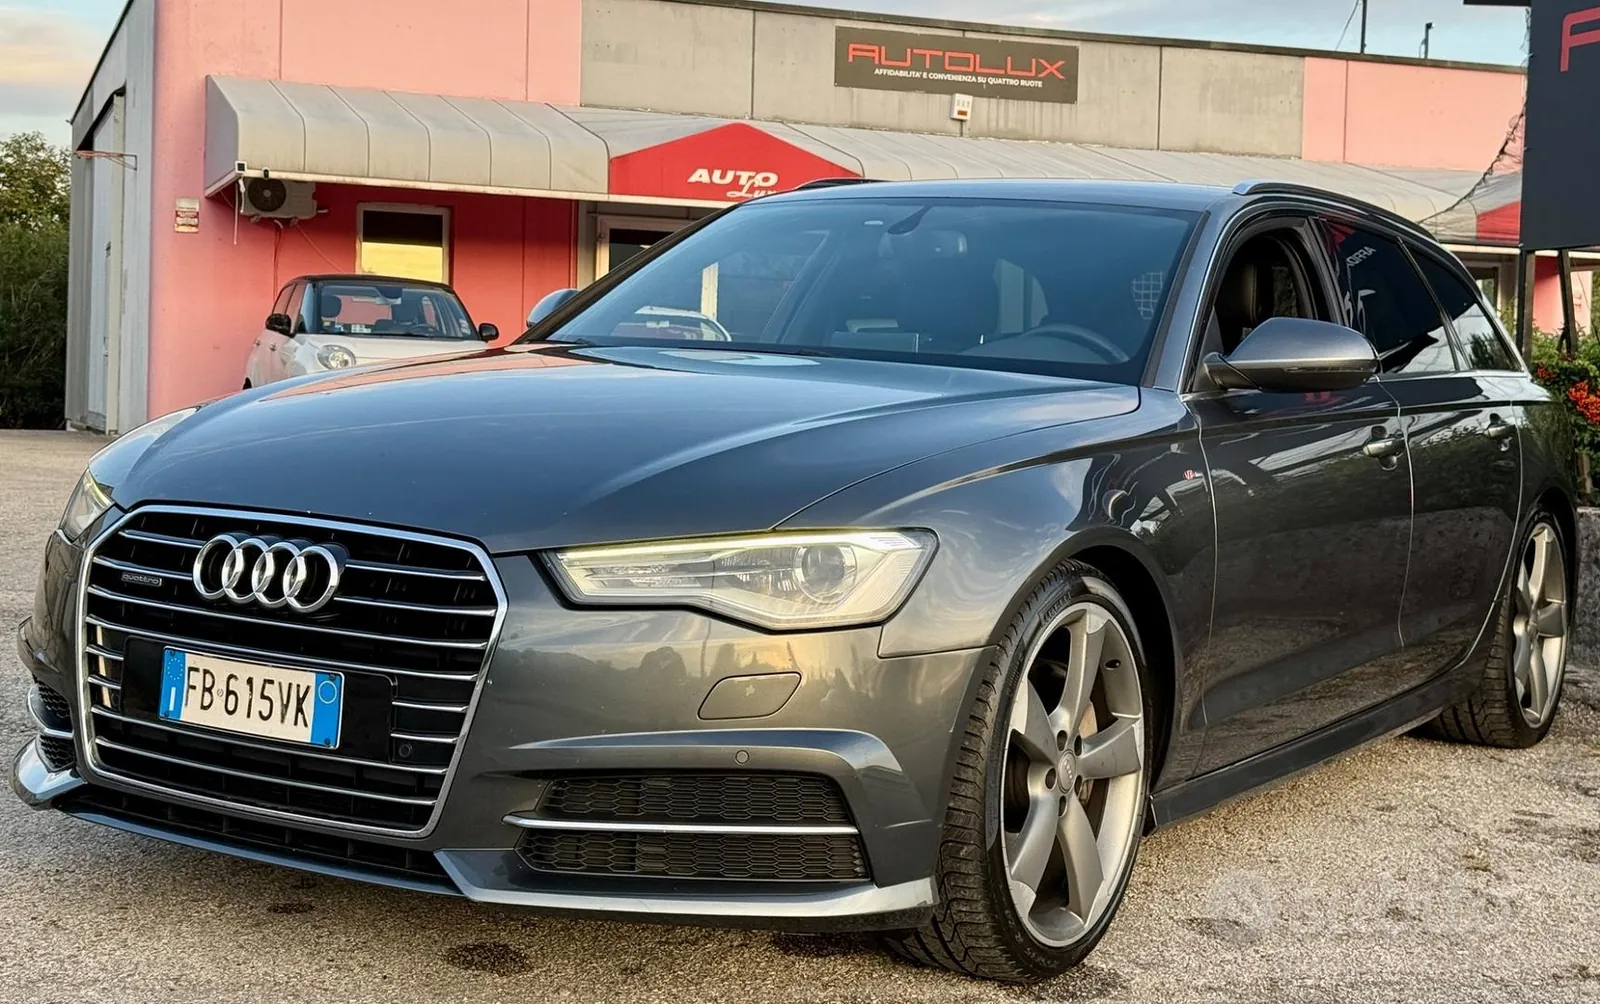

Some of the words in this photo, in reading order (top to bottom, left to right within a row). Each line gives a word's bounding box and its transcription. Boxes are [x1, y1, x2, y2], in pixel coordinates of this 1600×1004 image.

[847, 43, 1066, 79] AUTOLUX
[922, 71, 928, 79] E
[928, 72, 976, 82] CONVENIENZA
[987, 77, 1019, 86] QUATTRO
[1020, 79, 1043, 88] RUOTE
[687, 168, 779, 187] AUTO
[122, 573, 159, 585] quattro
